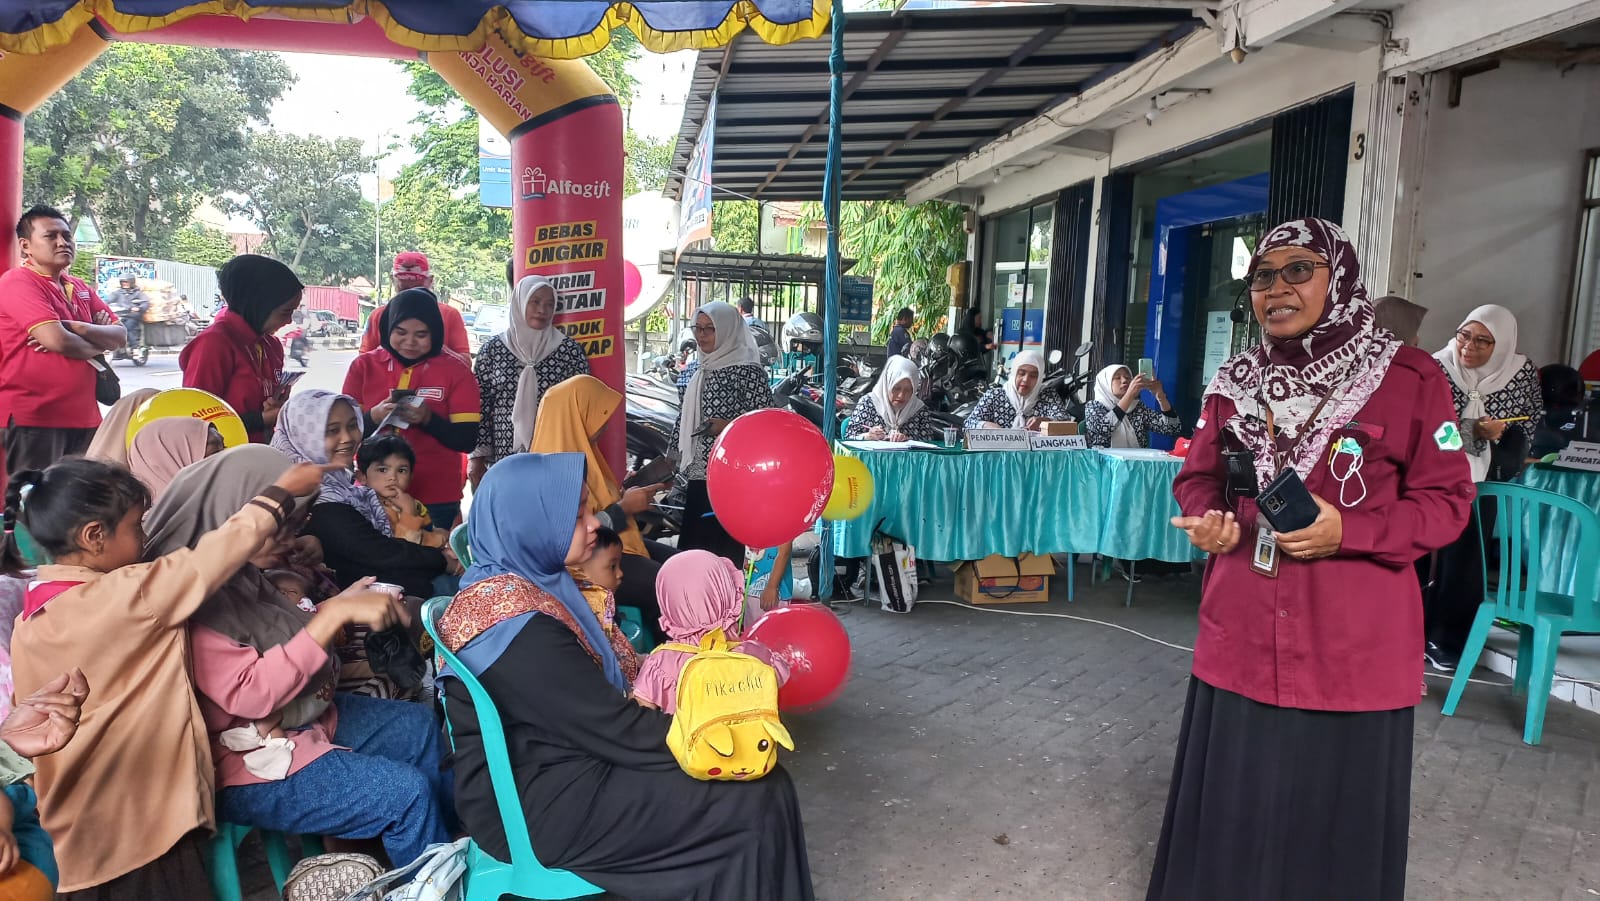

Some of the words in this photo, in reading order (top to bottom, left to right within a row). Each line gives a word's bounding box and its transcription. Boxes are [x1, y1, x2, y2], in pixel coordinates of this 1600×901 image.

[476, 42, 525, 91] LUSI
[487, 74, 532, 120] HARIAN
[1354, 133, 1365, 160] 3
[547, 179, 611, 199] Alfagift
[538, 223, 593, 241] BEBAS
[528, 242, 604, 264] ONGKIR
[554, 291, 603, 312] STAN
[971, 434, 1025, 442] PENDAFTARAN
[1034, 439, 1077, 449] LANGKAH
[1080, 438, 1084, 447] 1
